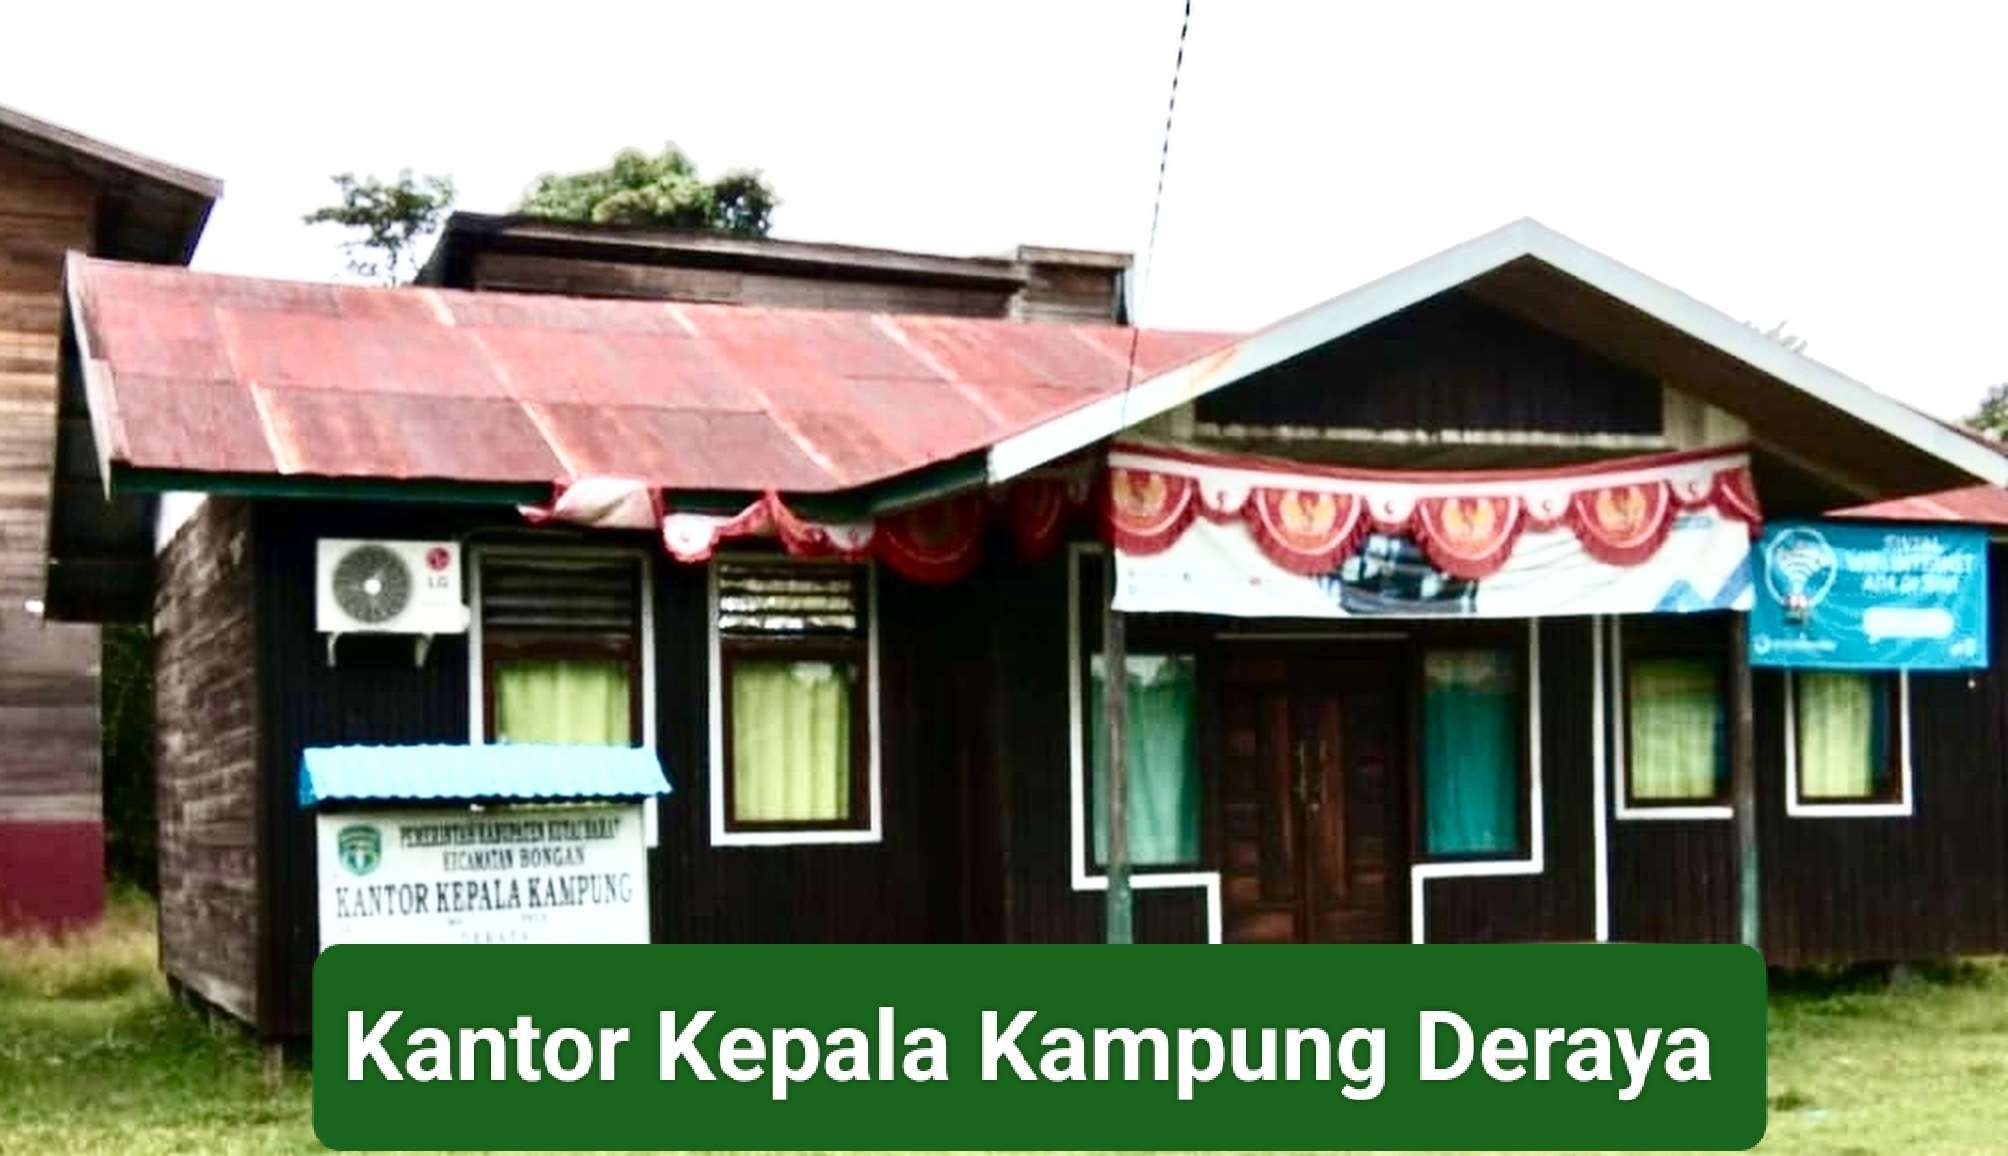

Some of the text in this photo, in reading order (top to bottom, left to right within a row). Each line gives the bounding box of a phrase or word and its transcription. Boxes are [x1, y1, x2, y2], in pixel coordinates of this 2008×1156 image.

[428, 577, 448, 589] LG
[399, 822, 479, 849] PEMERINTAH
[480, 819, 545, 845] KABUPATEN
[442, 845, 586, 872] KECAMATAN BONGAN
[336, 872, 633, 918] KANTOR KEPALA KAMPUNG
